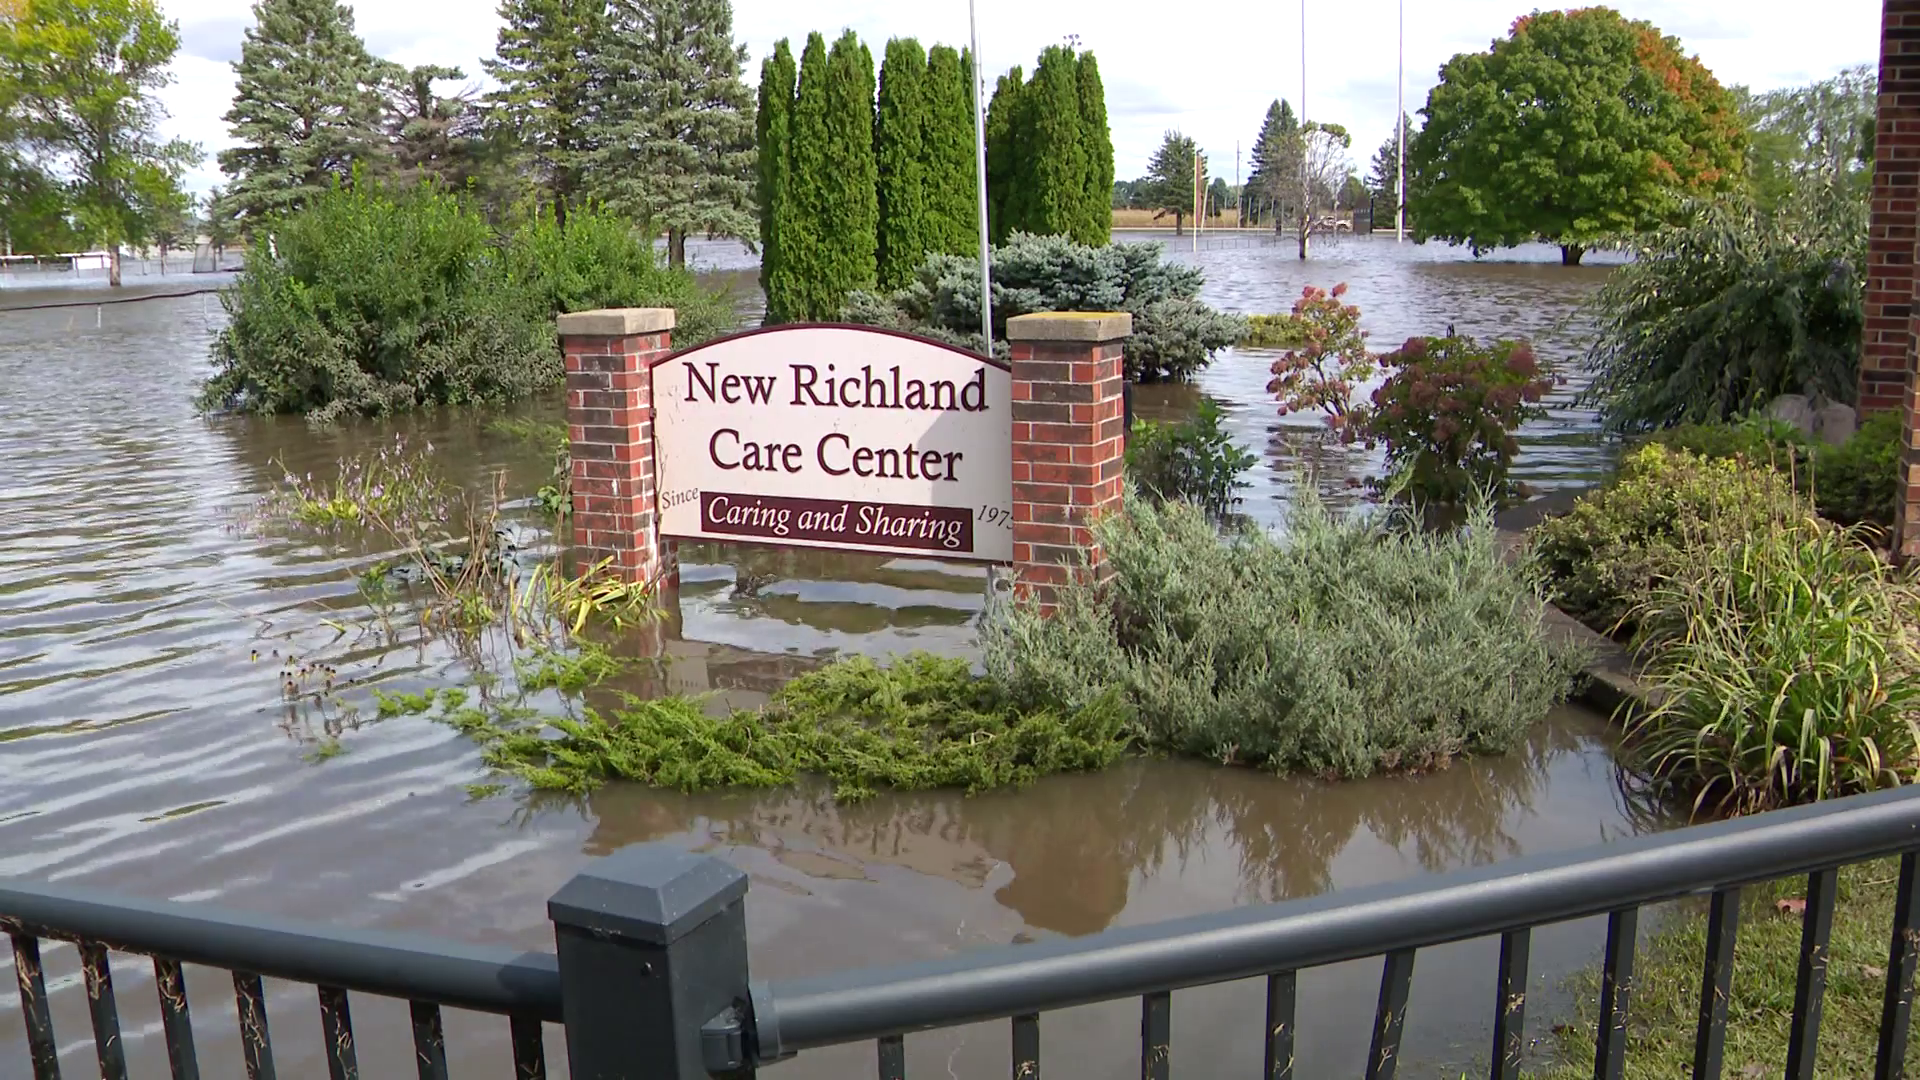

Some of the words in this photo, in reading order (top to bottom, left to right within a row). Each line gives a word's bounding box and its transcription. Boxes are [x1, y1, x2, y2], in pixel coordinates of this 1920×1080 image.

[682, 361, 777, 405] New
[789, 364, 989, 412] Richland
[709, 428, 802, 473] Care
[816, 432, 963, 481] Center
[661, 487, 699, 510] Since
[708, 496, 790, 535] Caring
[798, 504, 848, 533] and
[855, 510, 963, 547] Sharing
